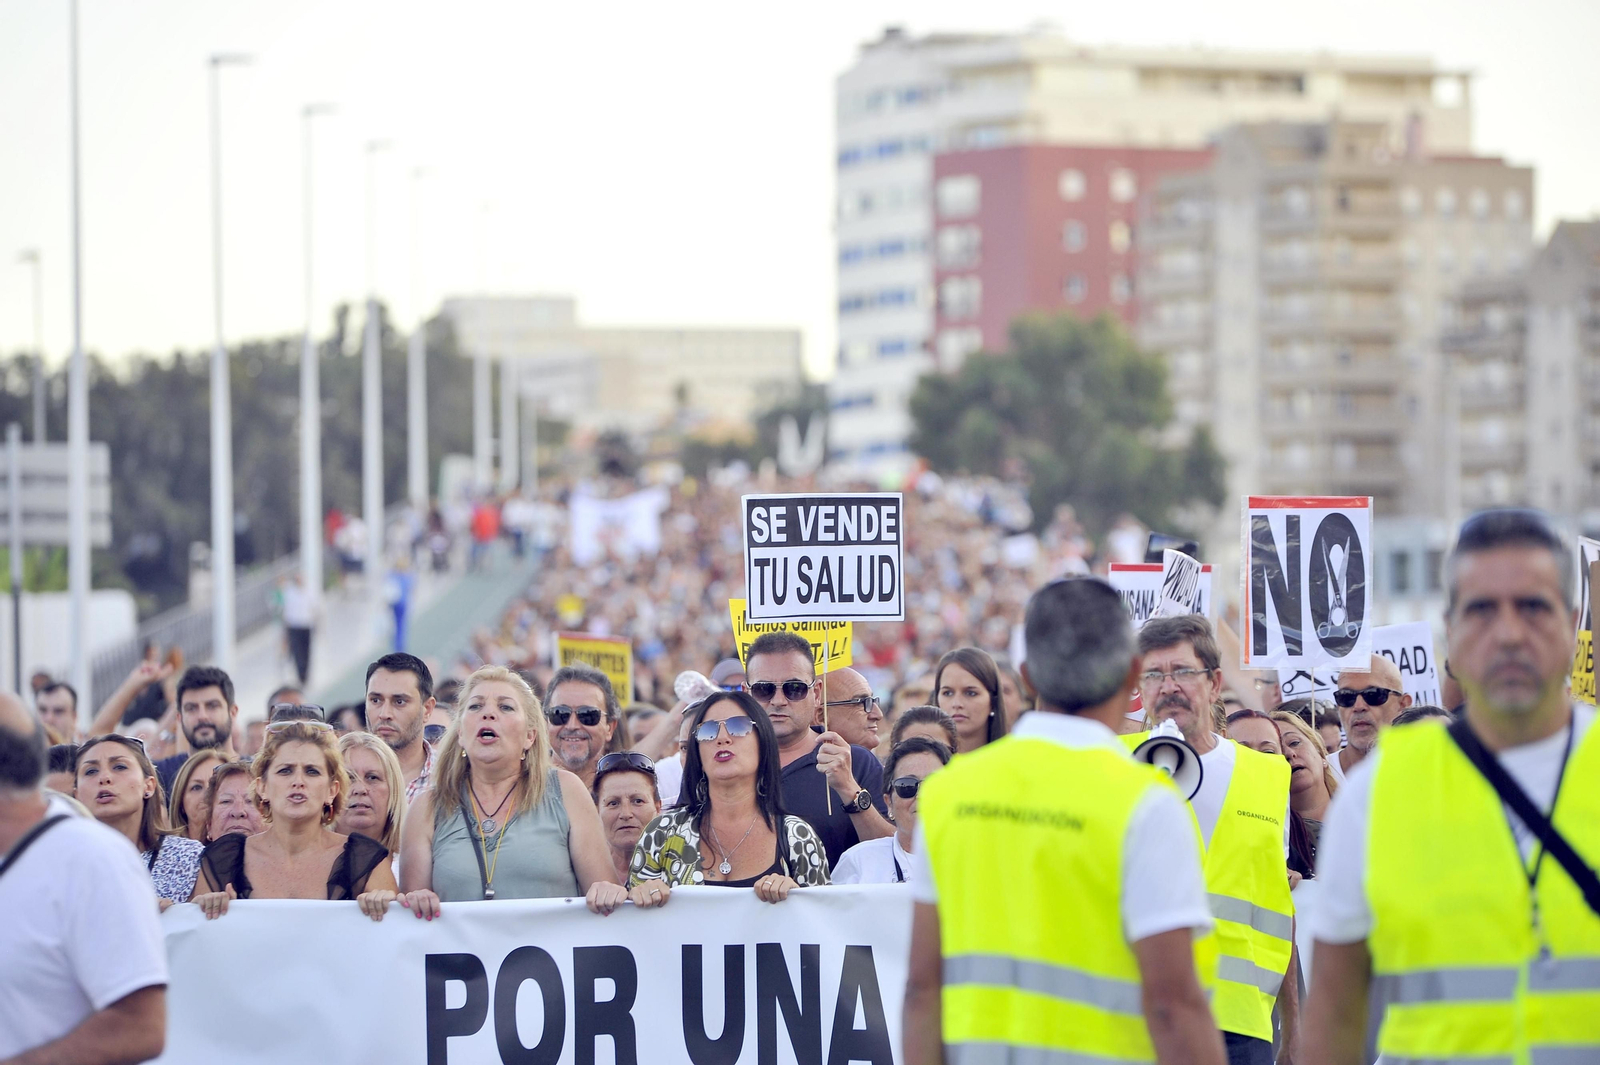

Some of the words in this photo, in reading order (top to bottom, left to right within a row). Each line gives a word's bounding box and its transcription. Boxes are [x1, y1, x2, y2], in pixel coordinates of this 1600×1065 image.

[751, 506, 787, 543] SE
[797, 505, 897, 543] VENDE
[754, 556, 789, 606] TU
[796, 554, 896, 604] SALUD
[1251, 512, 1365, 658] NO
[425, 945, 638, 1065] POR
[681, 942, 895, 1065] UNA
